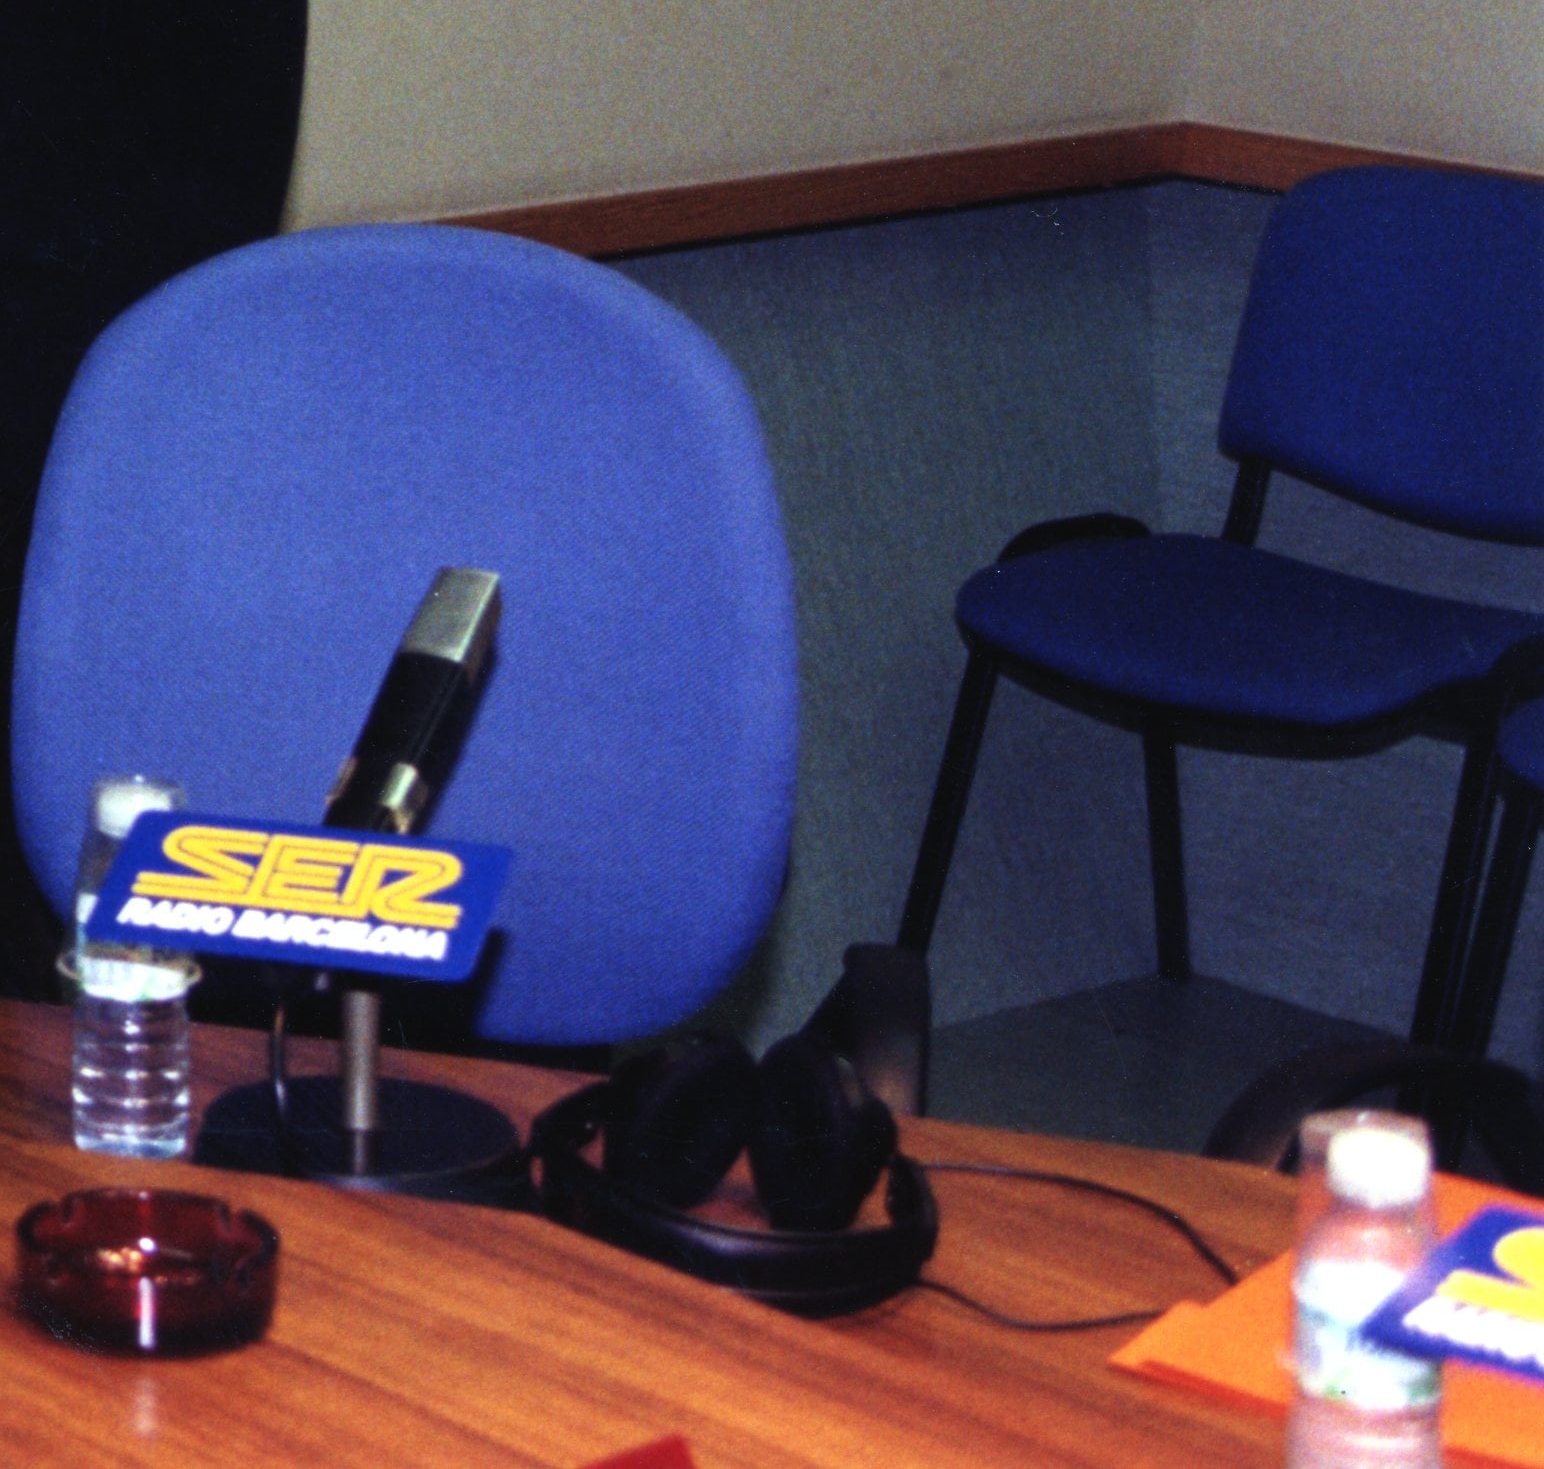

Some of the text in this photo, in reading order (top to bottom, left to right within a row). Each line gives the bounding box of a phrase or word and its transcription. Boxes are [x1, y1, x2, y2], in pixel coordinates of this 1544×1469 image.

[131, 826, 462, 928] SER
[117, 896, 447, 960] RADIO BARCELONA
